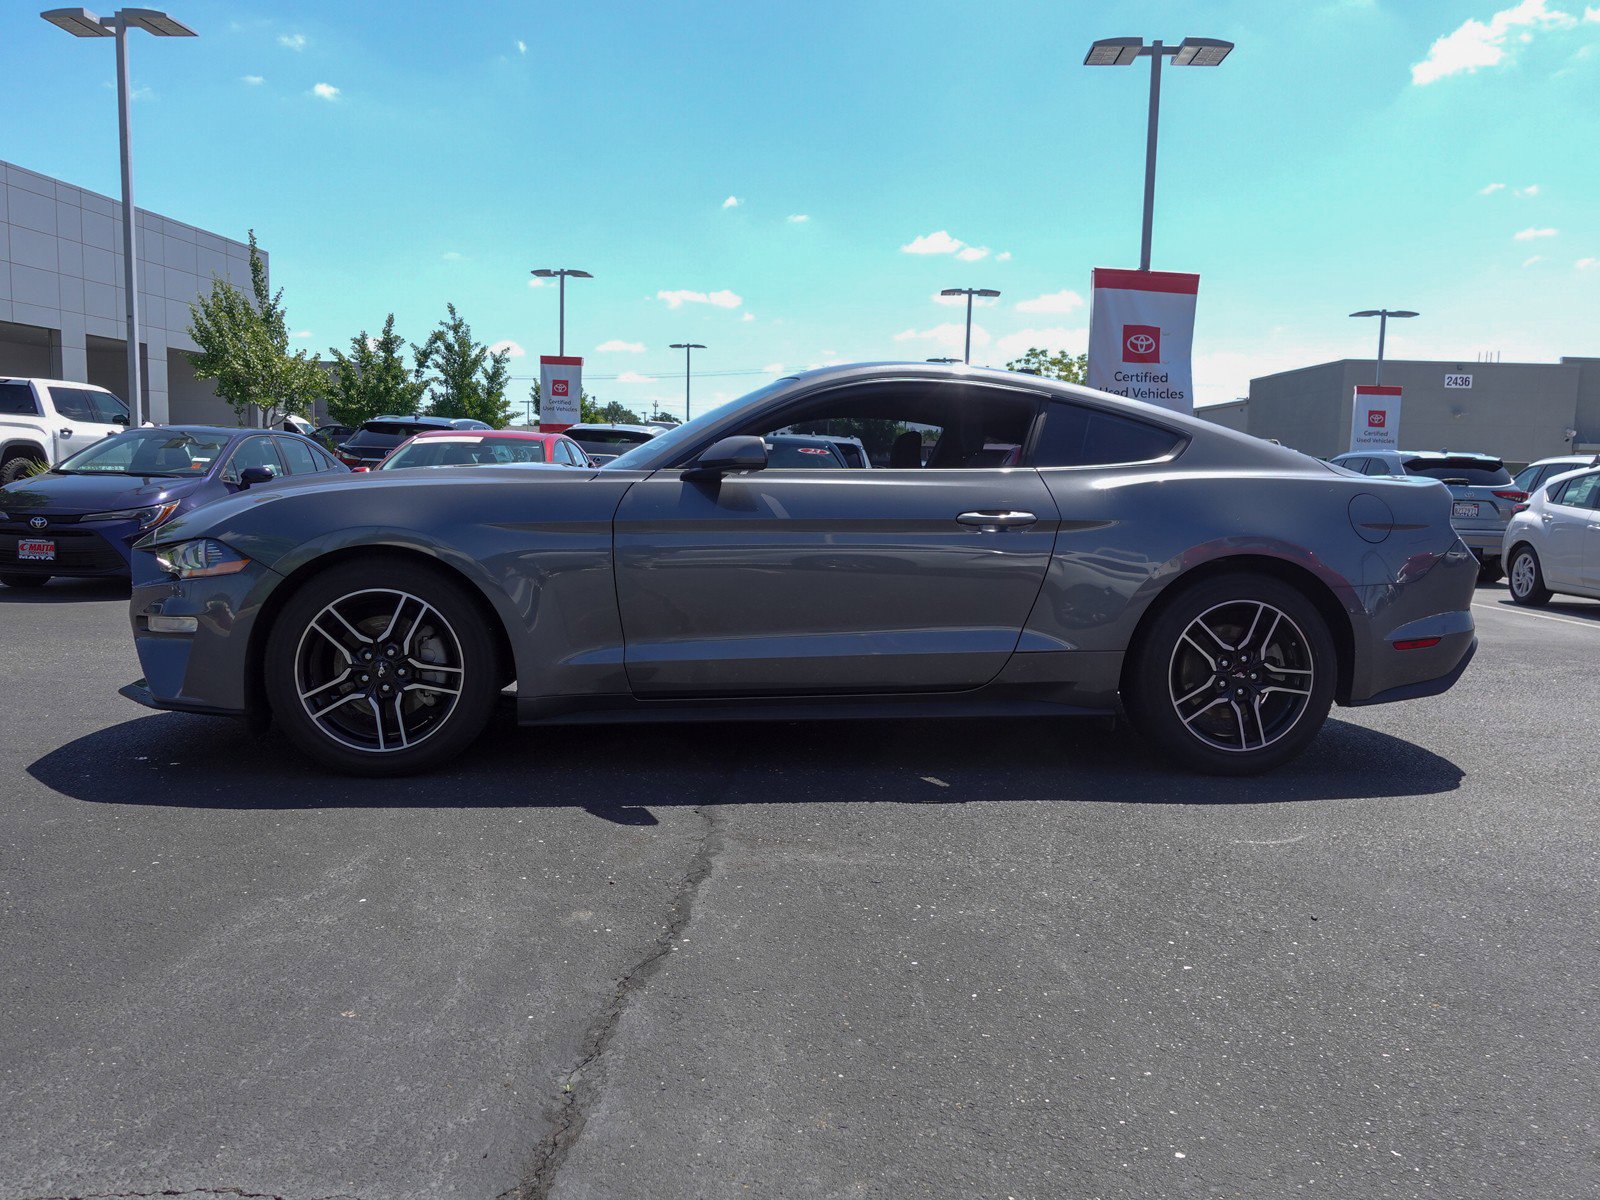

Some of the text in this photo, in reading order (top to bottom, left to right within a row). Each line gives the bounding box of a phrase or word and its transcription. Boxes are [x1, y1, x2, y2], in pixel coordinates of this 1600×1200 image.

[1114, 371, 1168, 383] Certified
[1446, 376, 1470, 387] 2436
[1132, 388, 1184, 399] Vehicles
[29, 543, 55, 552] MAITA
